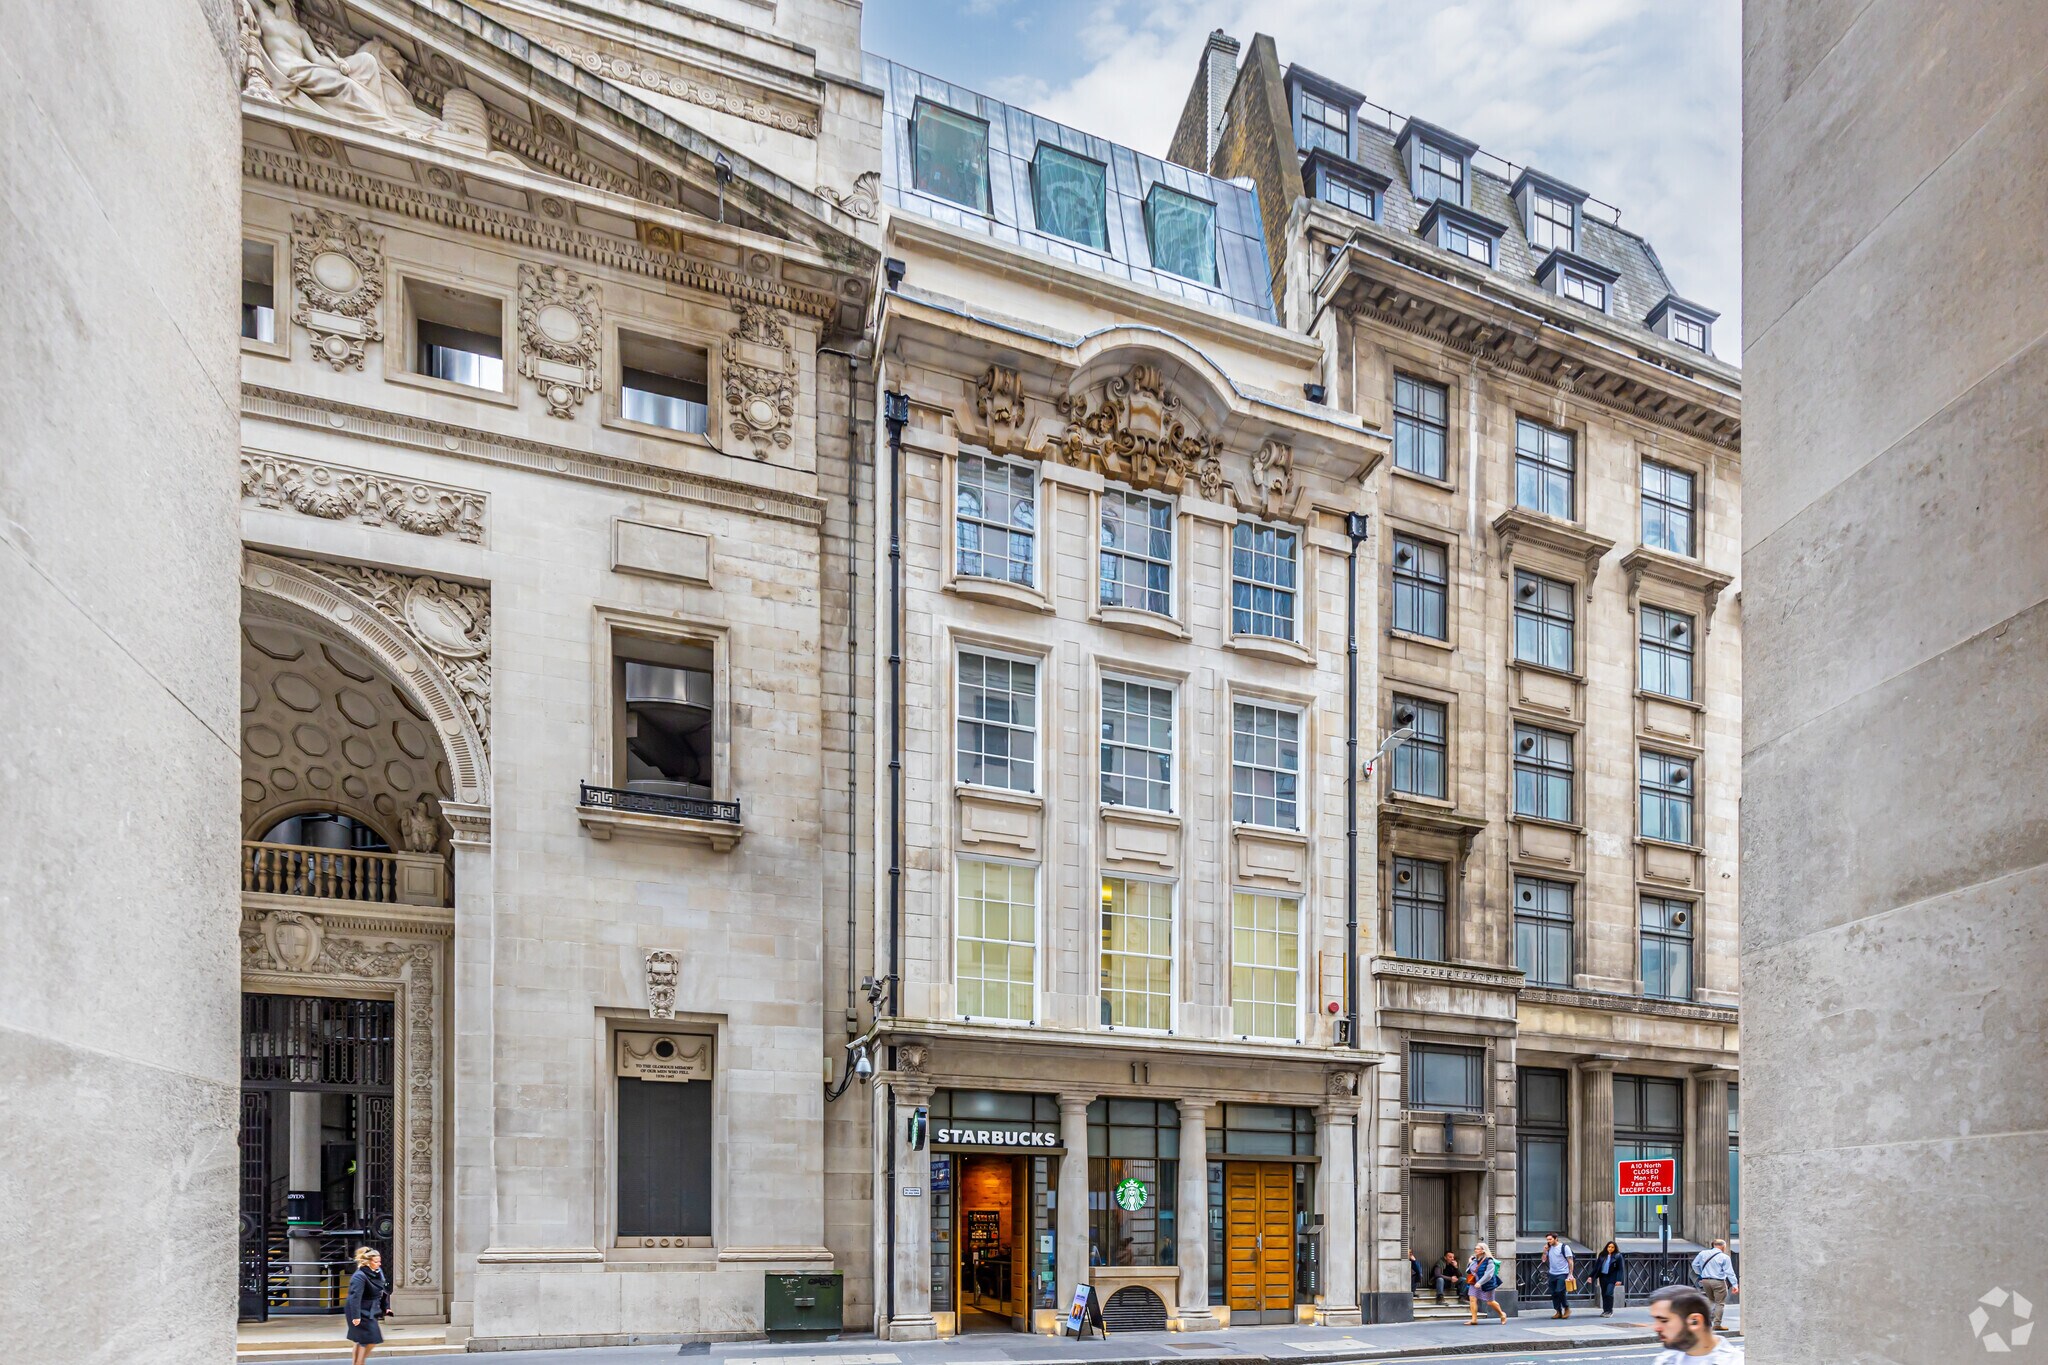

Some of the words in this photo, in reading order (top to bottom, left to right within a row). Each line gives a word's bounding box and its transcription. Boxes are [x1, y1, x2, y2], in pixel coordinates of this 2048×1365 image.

[1131, 1062, 1150, 1084] 11
[937, 1129, 1056, 1146] STARBUCKS
[1209, 1209, 1217, 1223] 11
